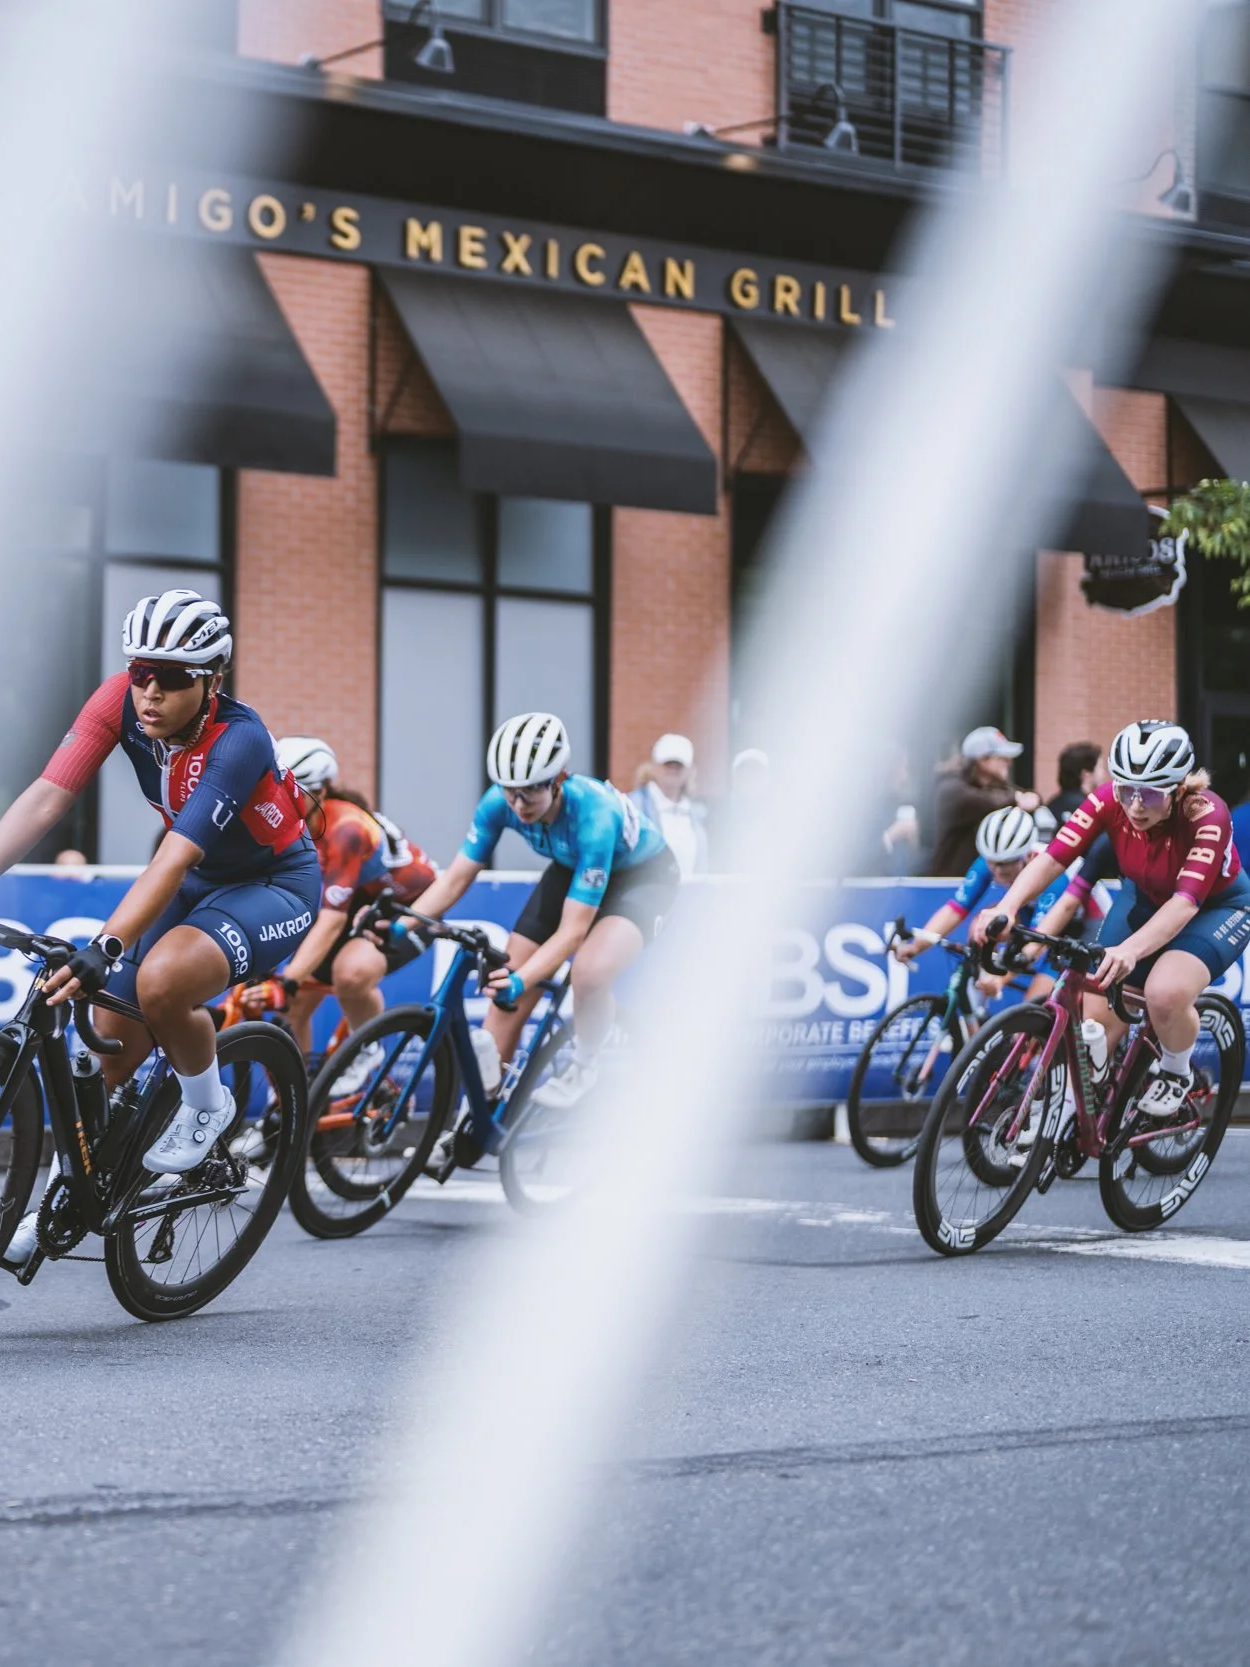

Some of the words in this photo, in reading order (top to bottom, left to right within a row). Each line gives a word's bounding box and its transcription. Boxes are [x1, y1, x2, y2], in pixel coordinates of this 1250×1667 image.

[405, 217, 695, 299] MEXICAN
[731, 268, 896, 329] GRILL
[190, 620, 218, 646] MET
[1177, 824, 1222, 882] TBD
[220, 921, 249, 974] 1000
[259, 911, 312, 942] JAKROO
